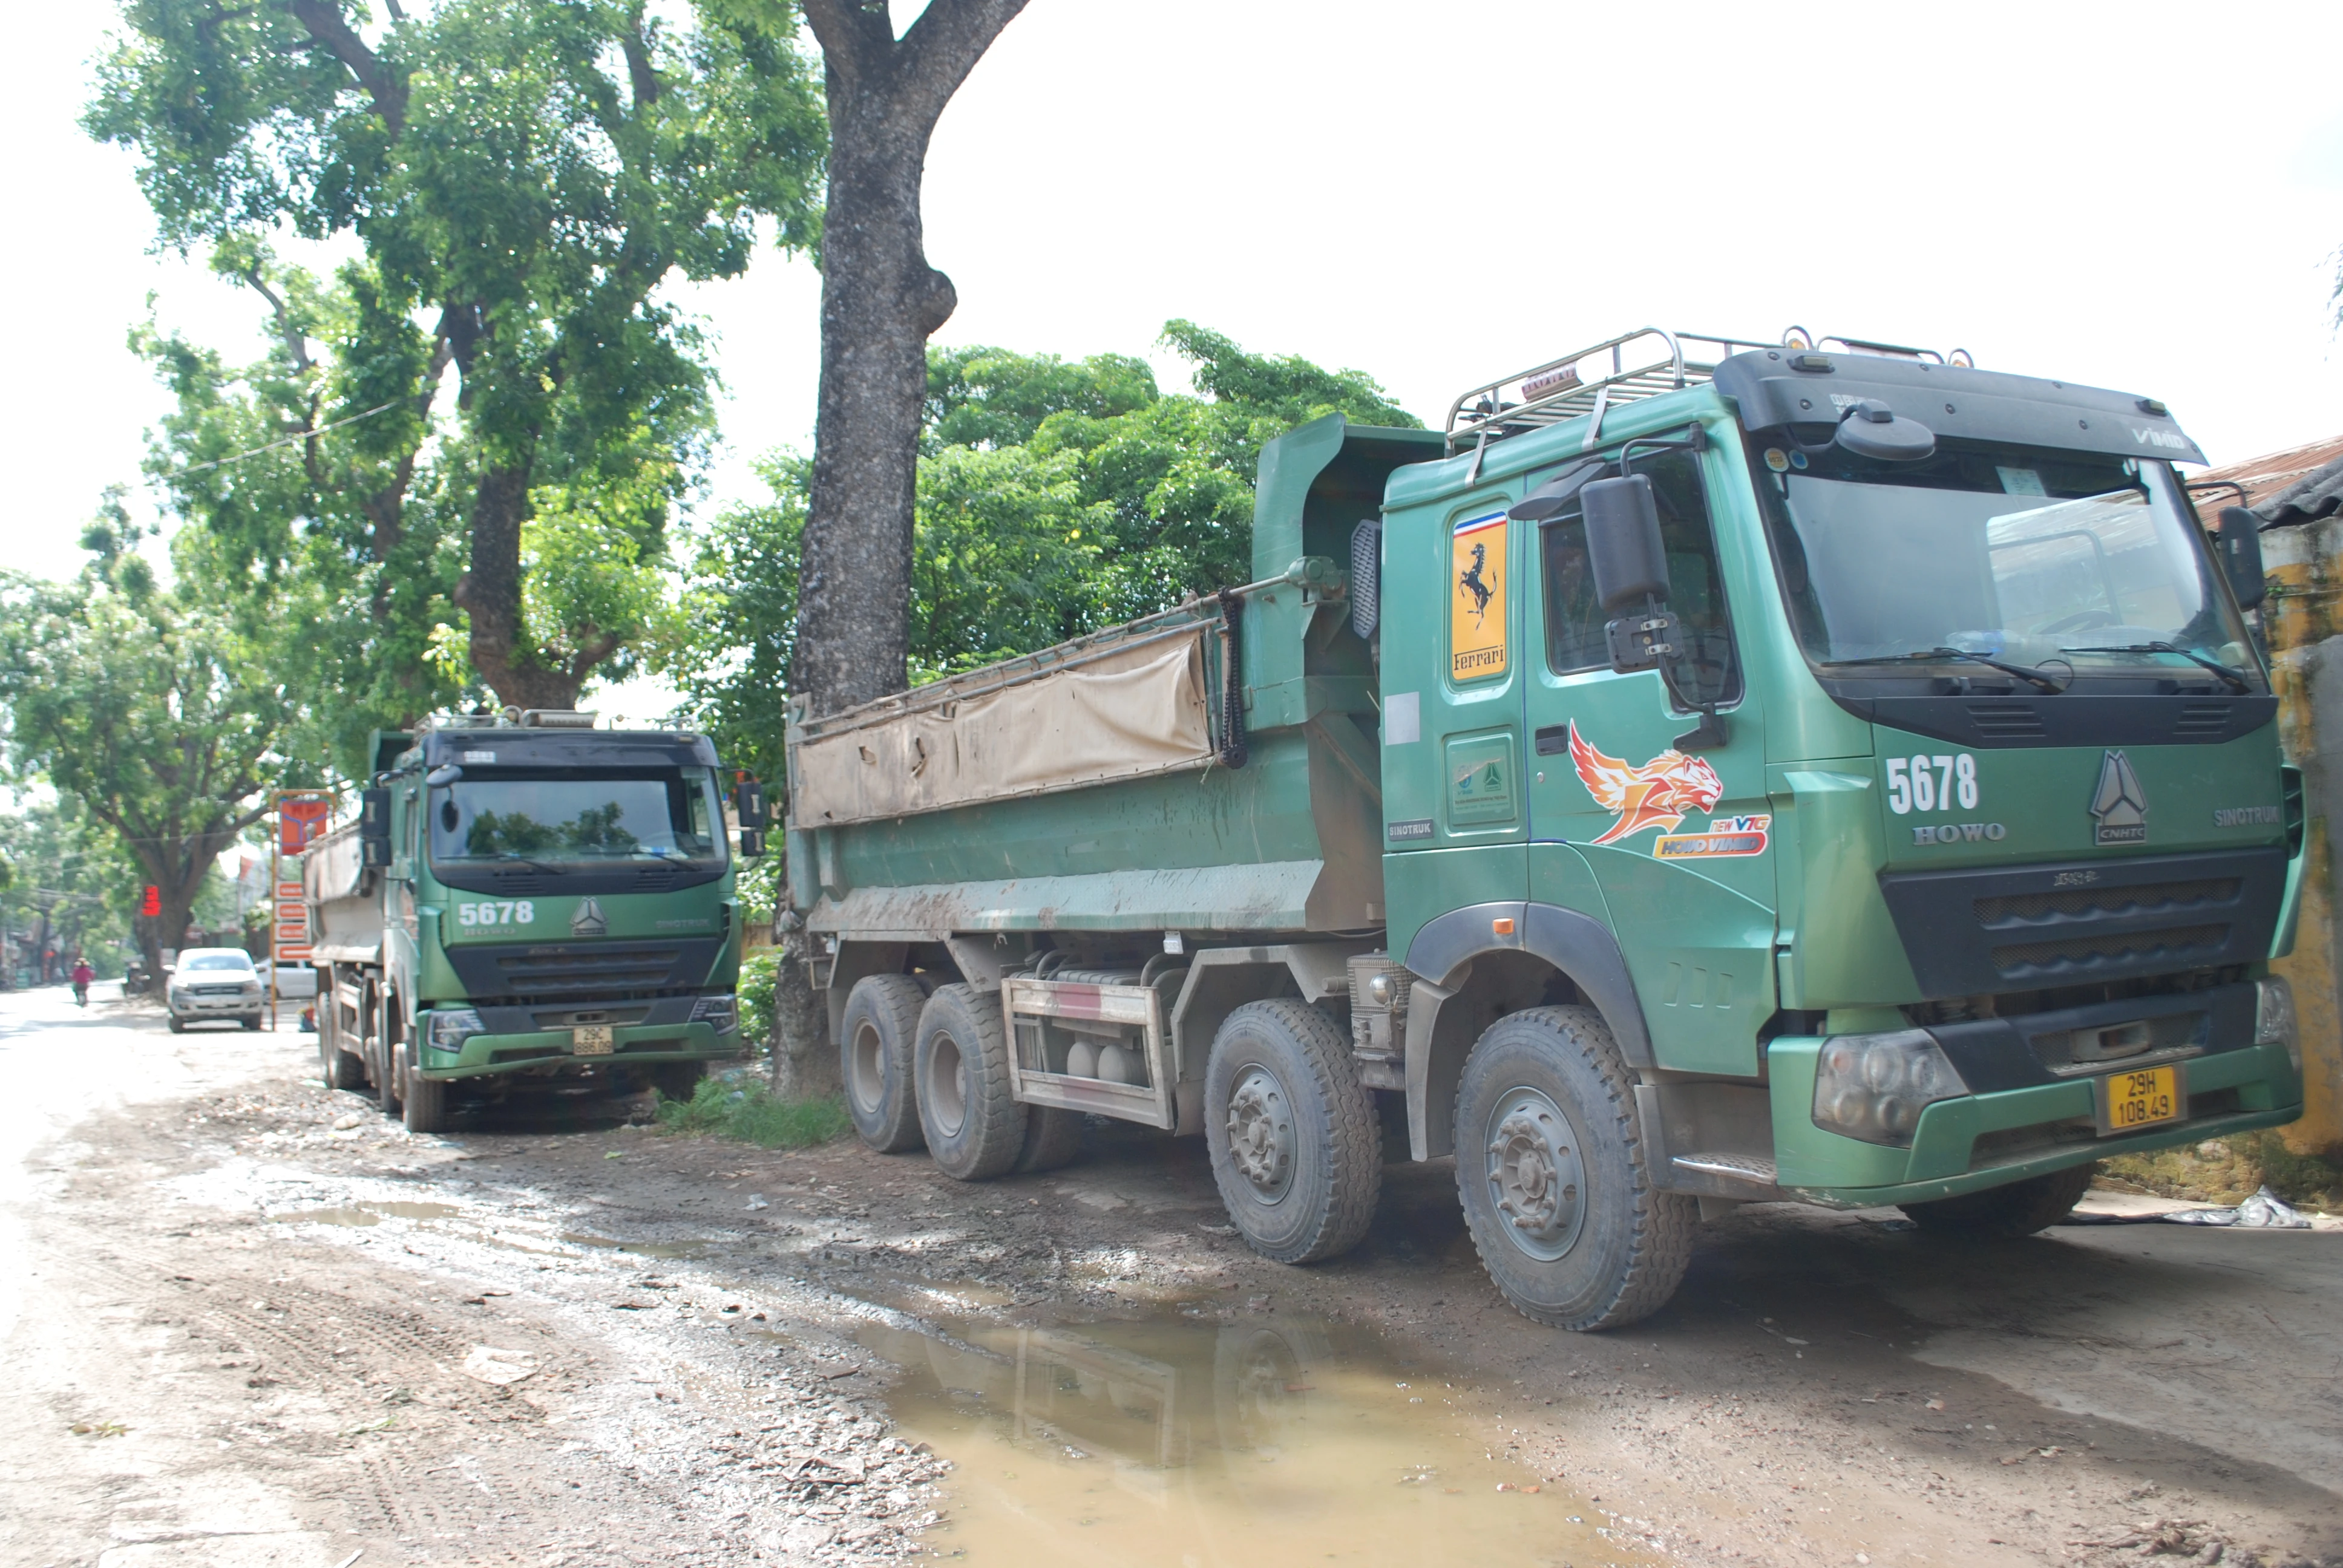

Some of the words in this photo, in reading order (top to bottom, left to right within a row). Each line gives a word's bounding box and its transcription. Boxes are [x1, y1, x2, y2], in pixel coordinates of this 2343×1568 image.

[1453, 644, 1504, 671] Ferrari
[1886, 753, 1978, 814] 5678
[2214, 806, 2281, 827] SINOTRUK
[1389, 823, 1431, 836] SINOTRUK
[1912, 823, 2006, 846] HOWO
[2100, 828, 2145, 839] CNHTC
[1661, 839, 1707, 855] HOWO
[458, 900, 534, 926] 5678
[2127, 1071, 2155, 1097] 29H
[2119, 1094, 2168, 1124] 108.49
